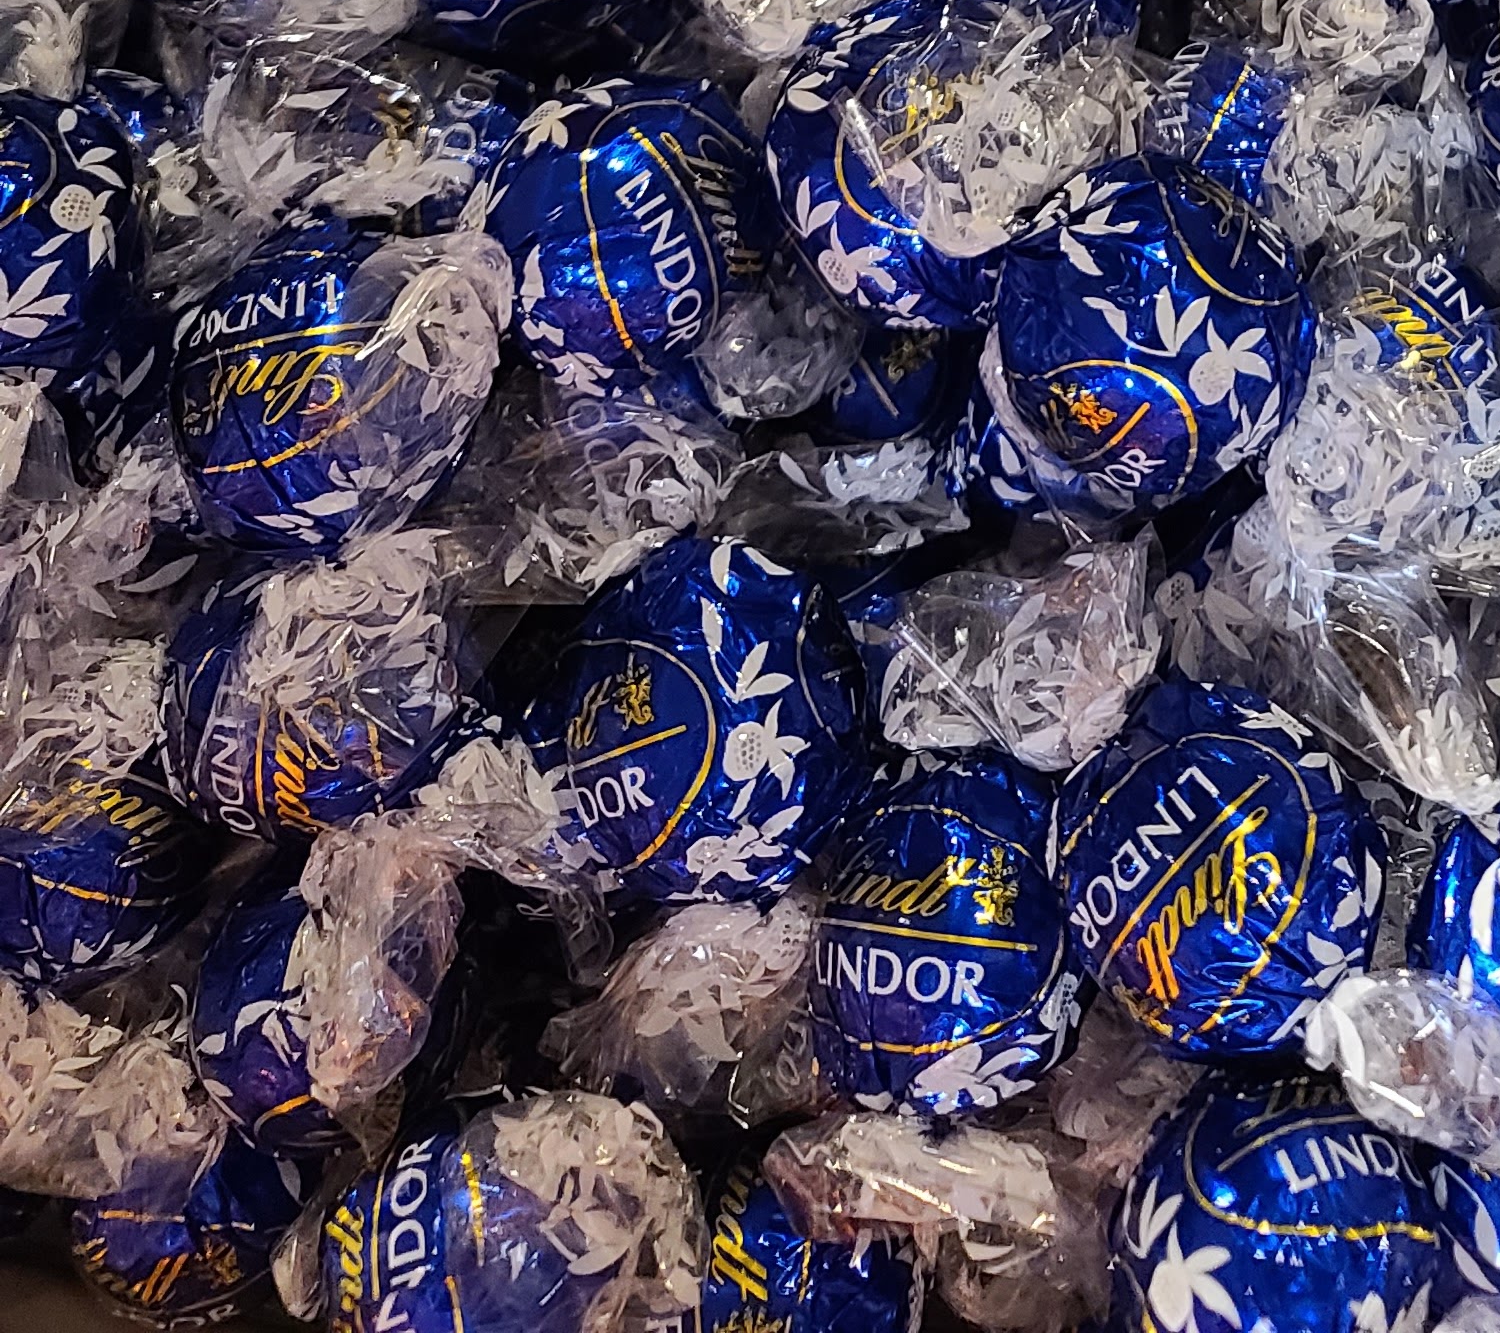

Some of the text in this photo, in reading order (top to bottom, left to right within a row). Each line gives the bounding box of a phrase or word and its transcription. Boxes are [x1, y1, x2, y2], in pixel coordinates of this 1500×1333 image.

[1154, 40, 1212, 144] LIND
[615, 169, 703, 352] LINDOR
[1383, 242, 1498, 391] LINDO
[209, 341, 366, 425] Lind
[206, 717, 260, 837] INDO
[273, 693, 347, 833] Lind
[574, 768, 655, 829] DOR
[1068, 765, 1222, 951] LINDOR
[1135, 804, 1284, 1003] Lindt
[814, 944, 987, 1009] LINDOR
[1272, 1131, 1425, 1197] LIND
[709, 1165, 769, 1302] indt
